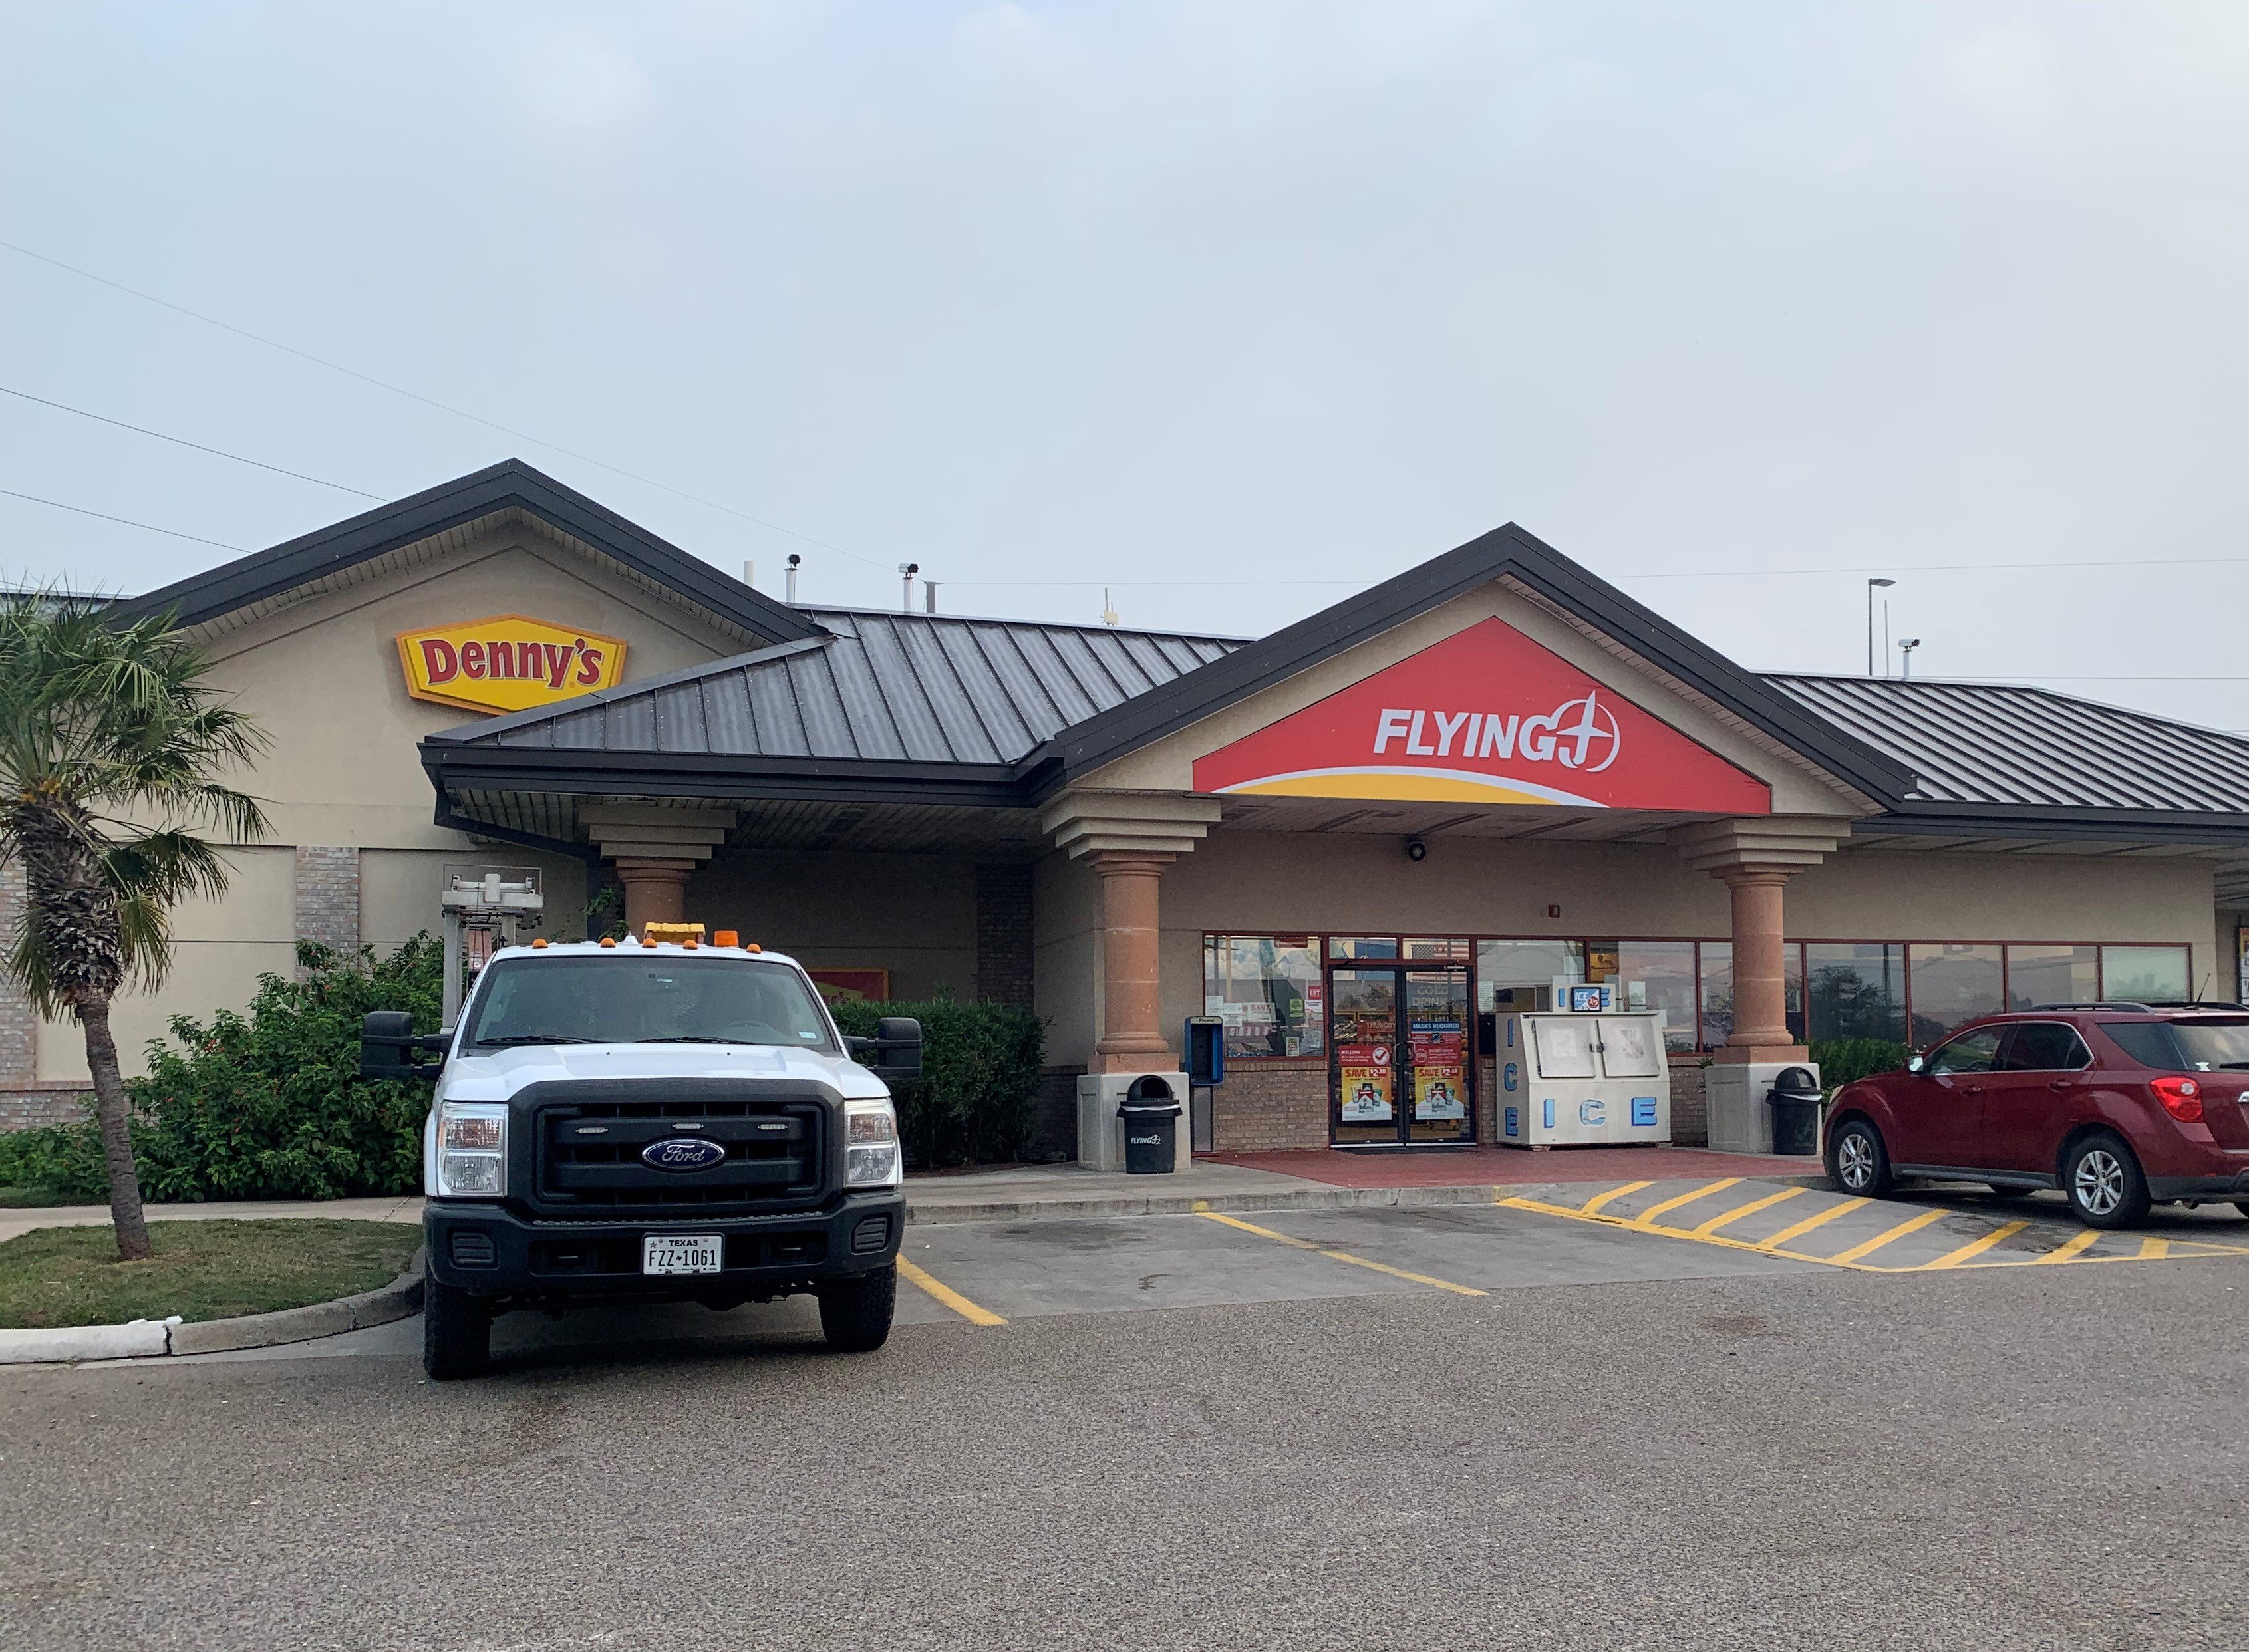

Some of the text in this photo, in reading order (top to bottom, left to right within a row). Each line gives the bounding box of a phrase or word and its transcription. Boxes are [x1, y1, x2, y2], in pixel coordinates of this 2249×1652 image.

[418, 638, 603, 690] Denny's
[1373, 708, 1557, 761] FLYING
[1417, 986, 1449, 995] COLD
[1574, 992, 1589, 1001] ICE
[1543, 1097, 1658, 1129] ICE
[661, 1144, 705, 1162] Ford
[649, 1250, 716, 1267] FZZ 1061
